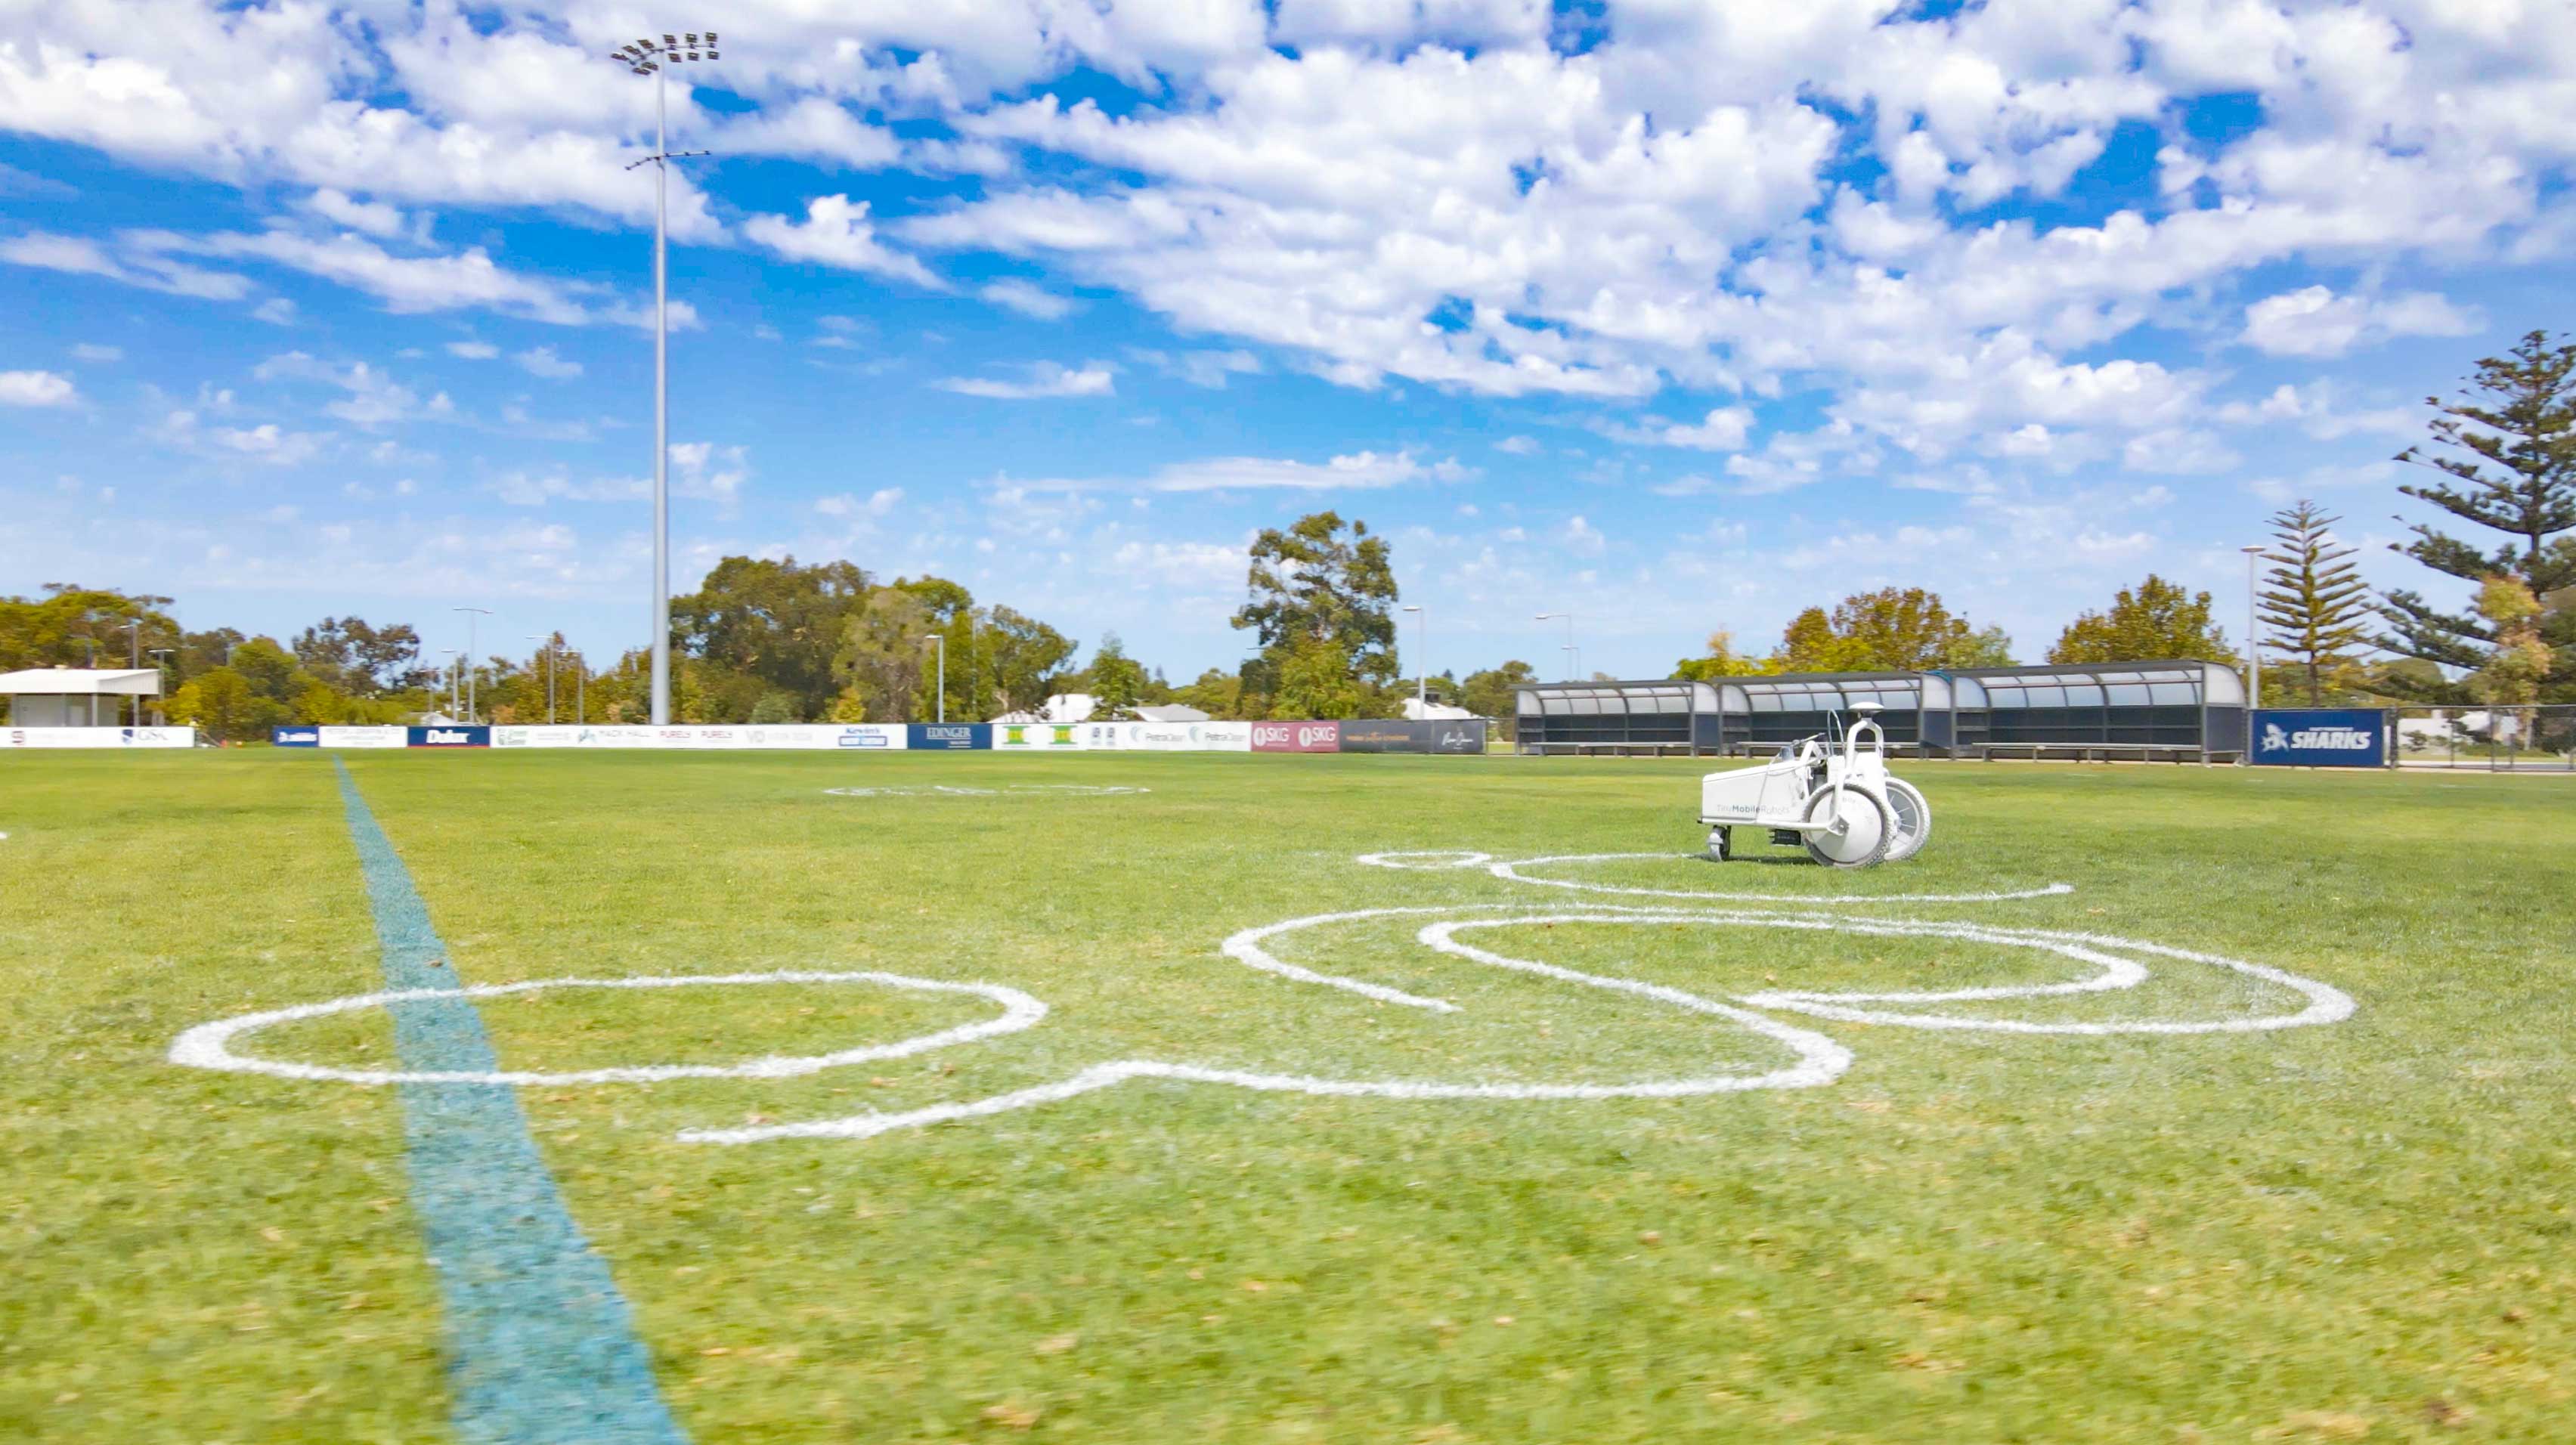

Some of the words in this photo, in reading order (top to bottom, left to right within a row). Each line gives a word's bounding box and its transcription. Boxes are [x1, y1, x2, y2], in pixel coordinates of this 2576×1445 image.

[1267, 727, 1290, 741] SKG
[1312, 727, 1336, 741] SKG
[2290, 732, 2372, 749] SHARKS
